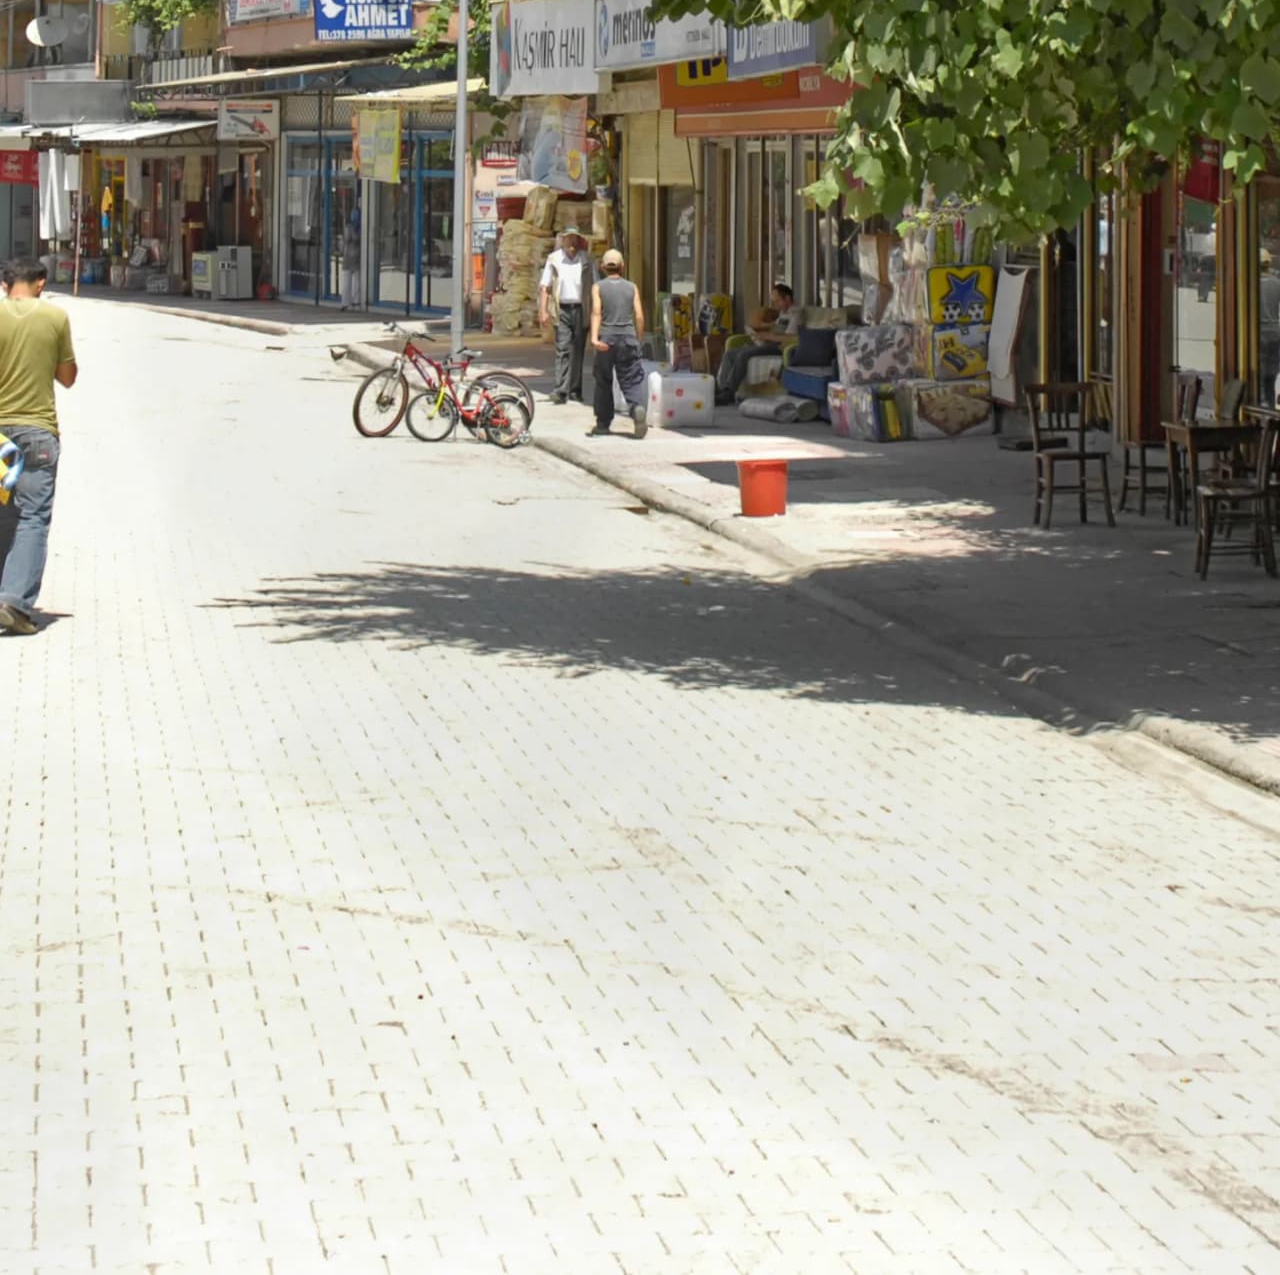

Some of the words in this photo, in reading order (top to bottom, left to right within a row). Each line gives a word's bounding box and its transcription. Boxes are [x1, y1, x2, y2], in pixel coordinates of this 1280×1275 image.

[344, 4, 409, 27] AHMET
[513, 18, 556, 76] KAŞMİR
[559, 26, 585, 68] HALI
